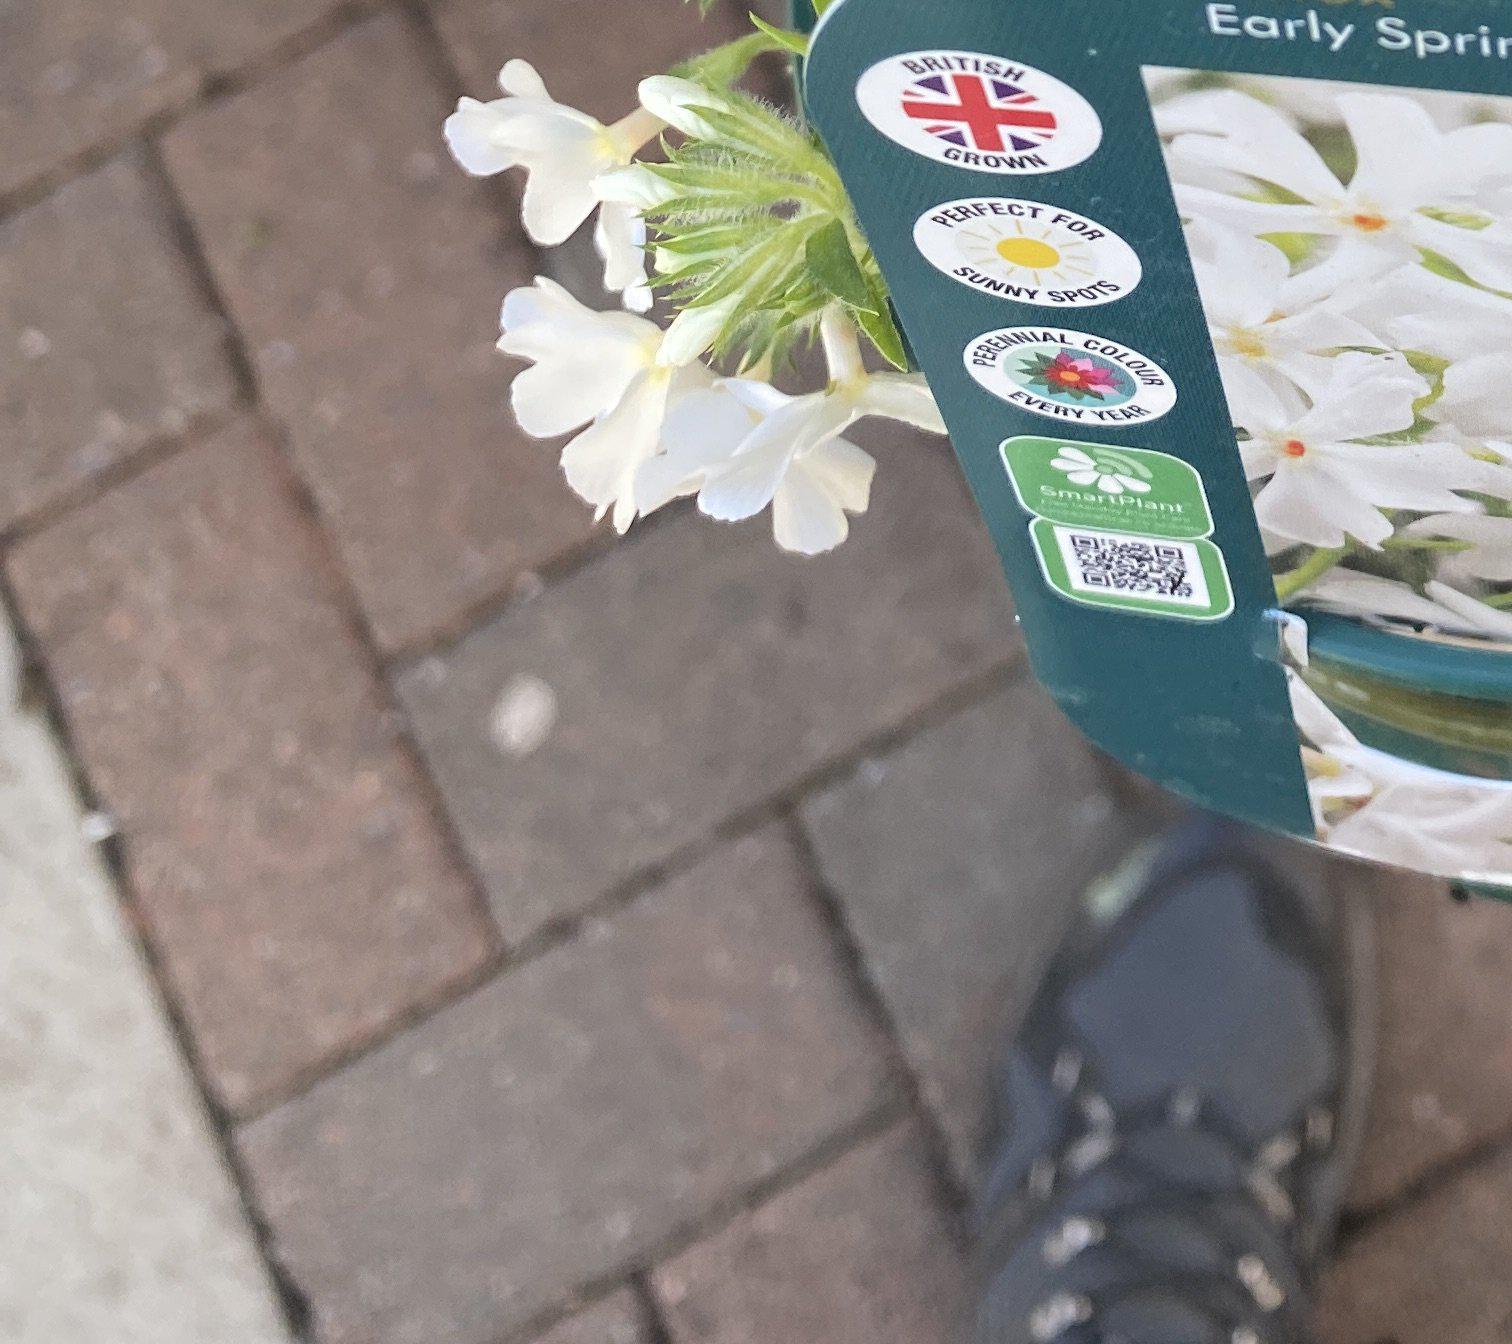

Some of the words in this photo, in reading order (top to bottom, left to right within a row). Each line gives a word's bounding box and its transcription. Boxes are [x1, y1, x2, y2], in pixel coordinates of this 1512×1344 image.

[1206, 2, 1355, 52] Early
[902, 55, 1026, 82] BRITISH
[942, 148, 1049, 169] GROWN
[931, 202, 1044, 228] PERFECT
[1051, 213, 1105, 241] FOR
[953, 266, 1039, 300] SUNNY
[1047, 280, 1121, 303] SPOTS
[972, 331, 1074, 368] PERENNIAL
[1083, 338, 1165, 387] COLOUR
[1008, 390, 1084, 419] EVERY
[1093, 403, 1151, 421] YEAR
[1039, 484, 1184, 513] SmartPlant
